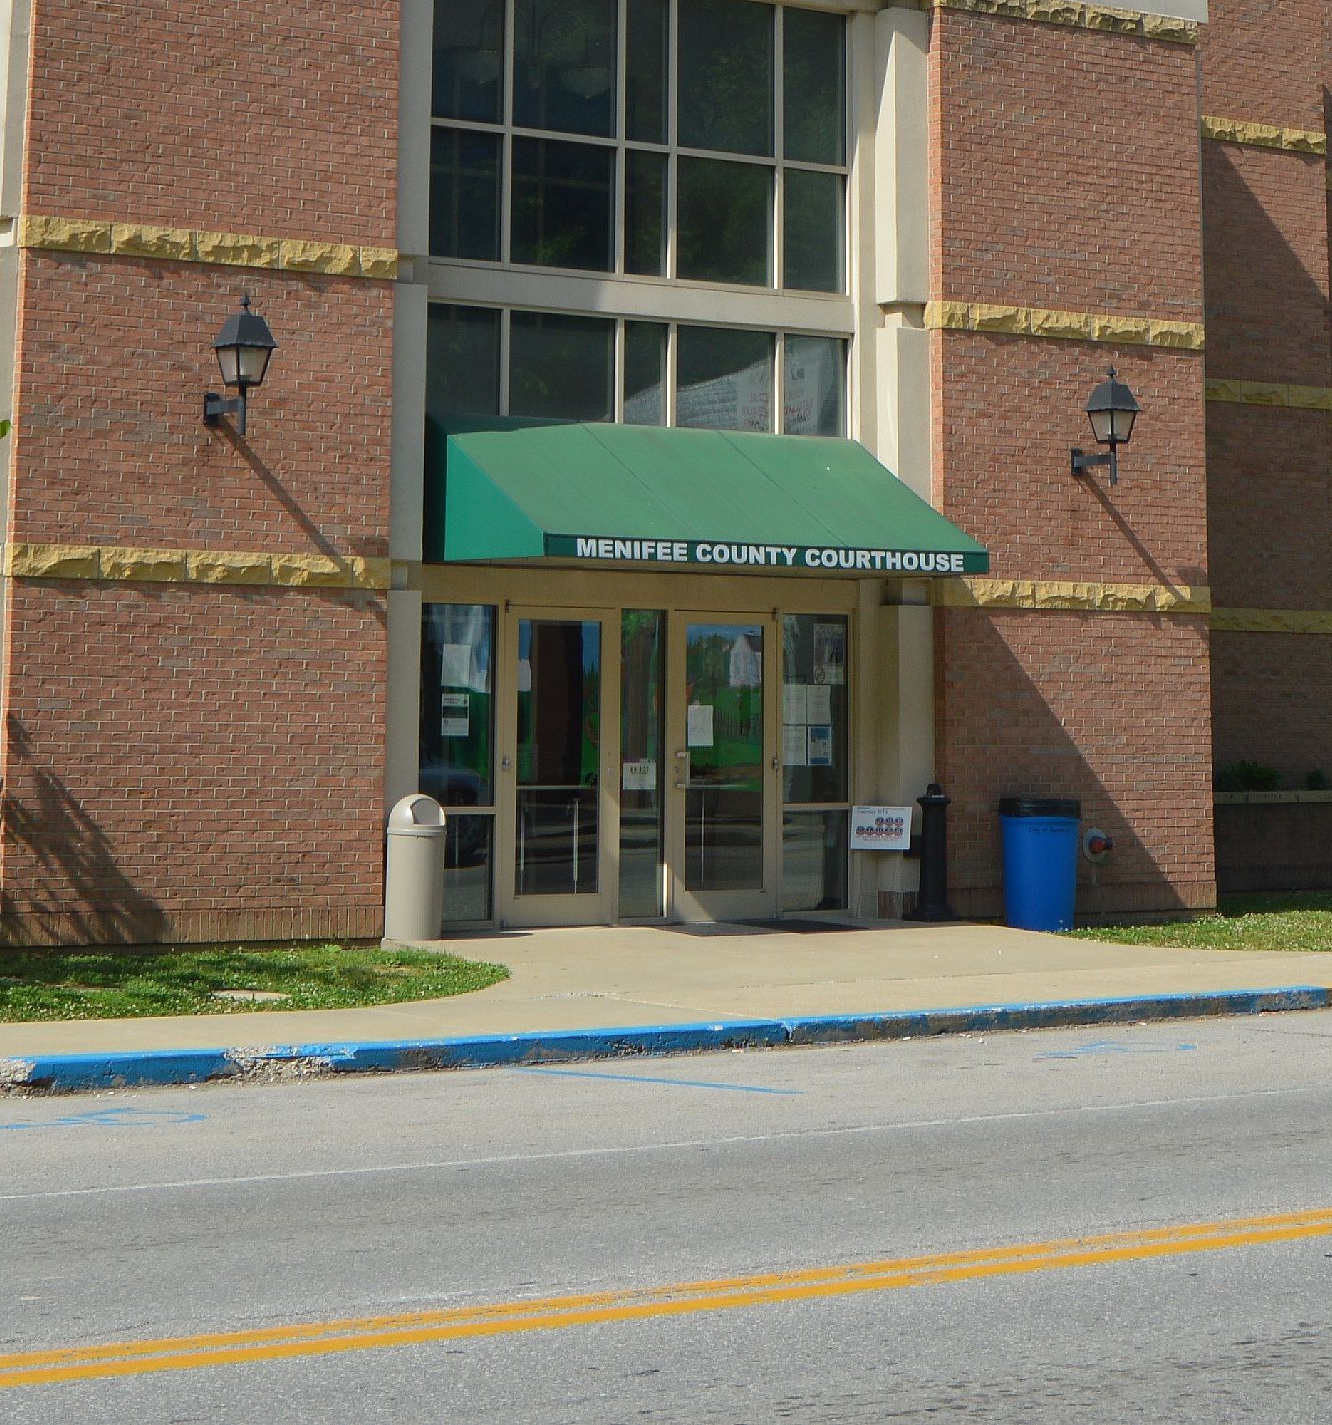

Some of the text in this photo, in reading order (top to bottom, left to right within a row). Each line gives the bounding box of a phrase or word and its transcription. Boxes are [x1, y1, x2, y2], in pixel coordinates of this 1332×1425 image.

[576, 538, 965, 573] MENIFEE COUNTY COURTHOUSE
